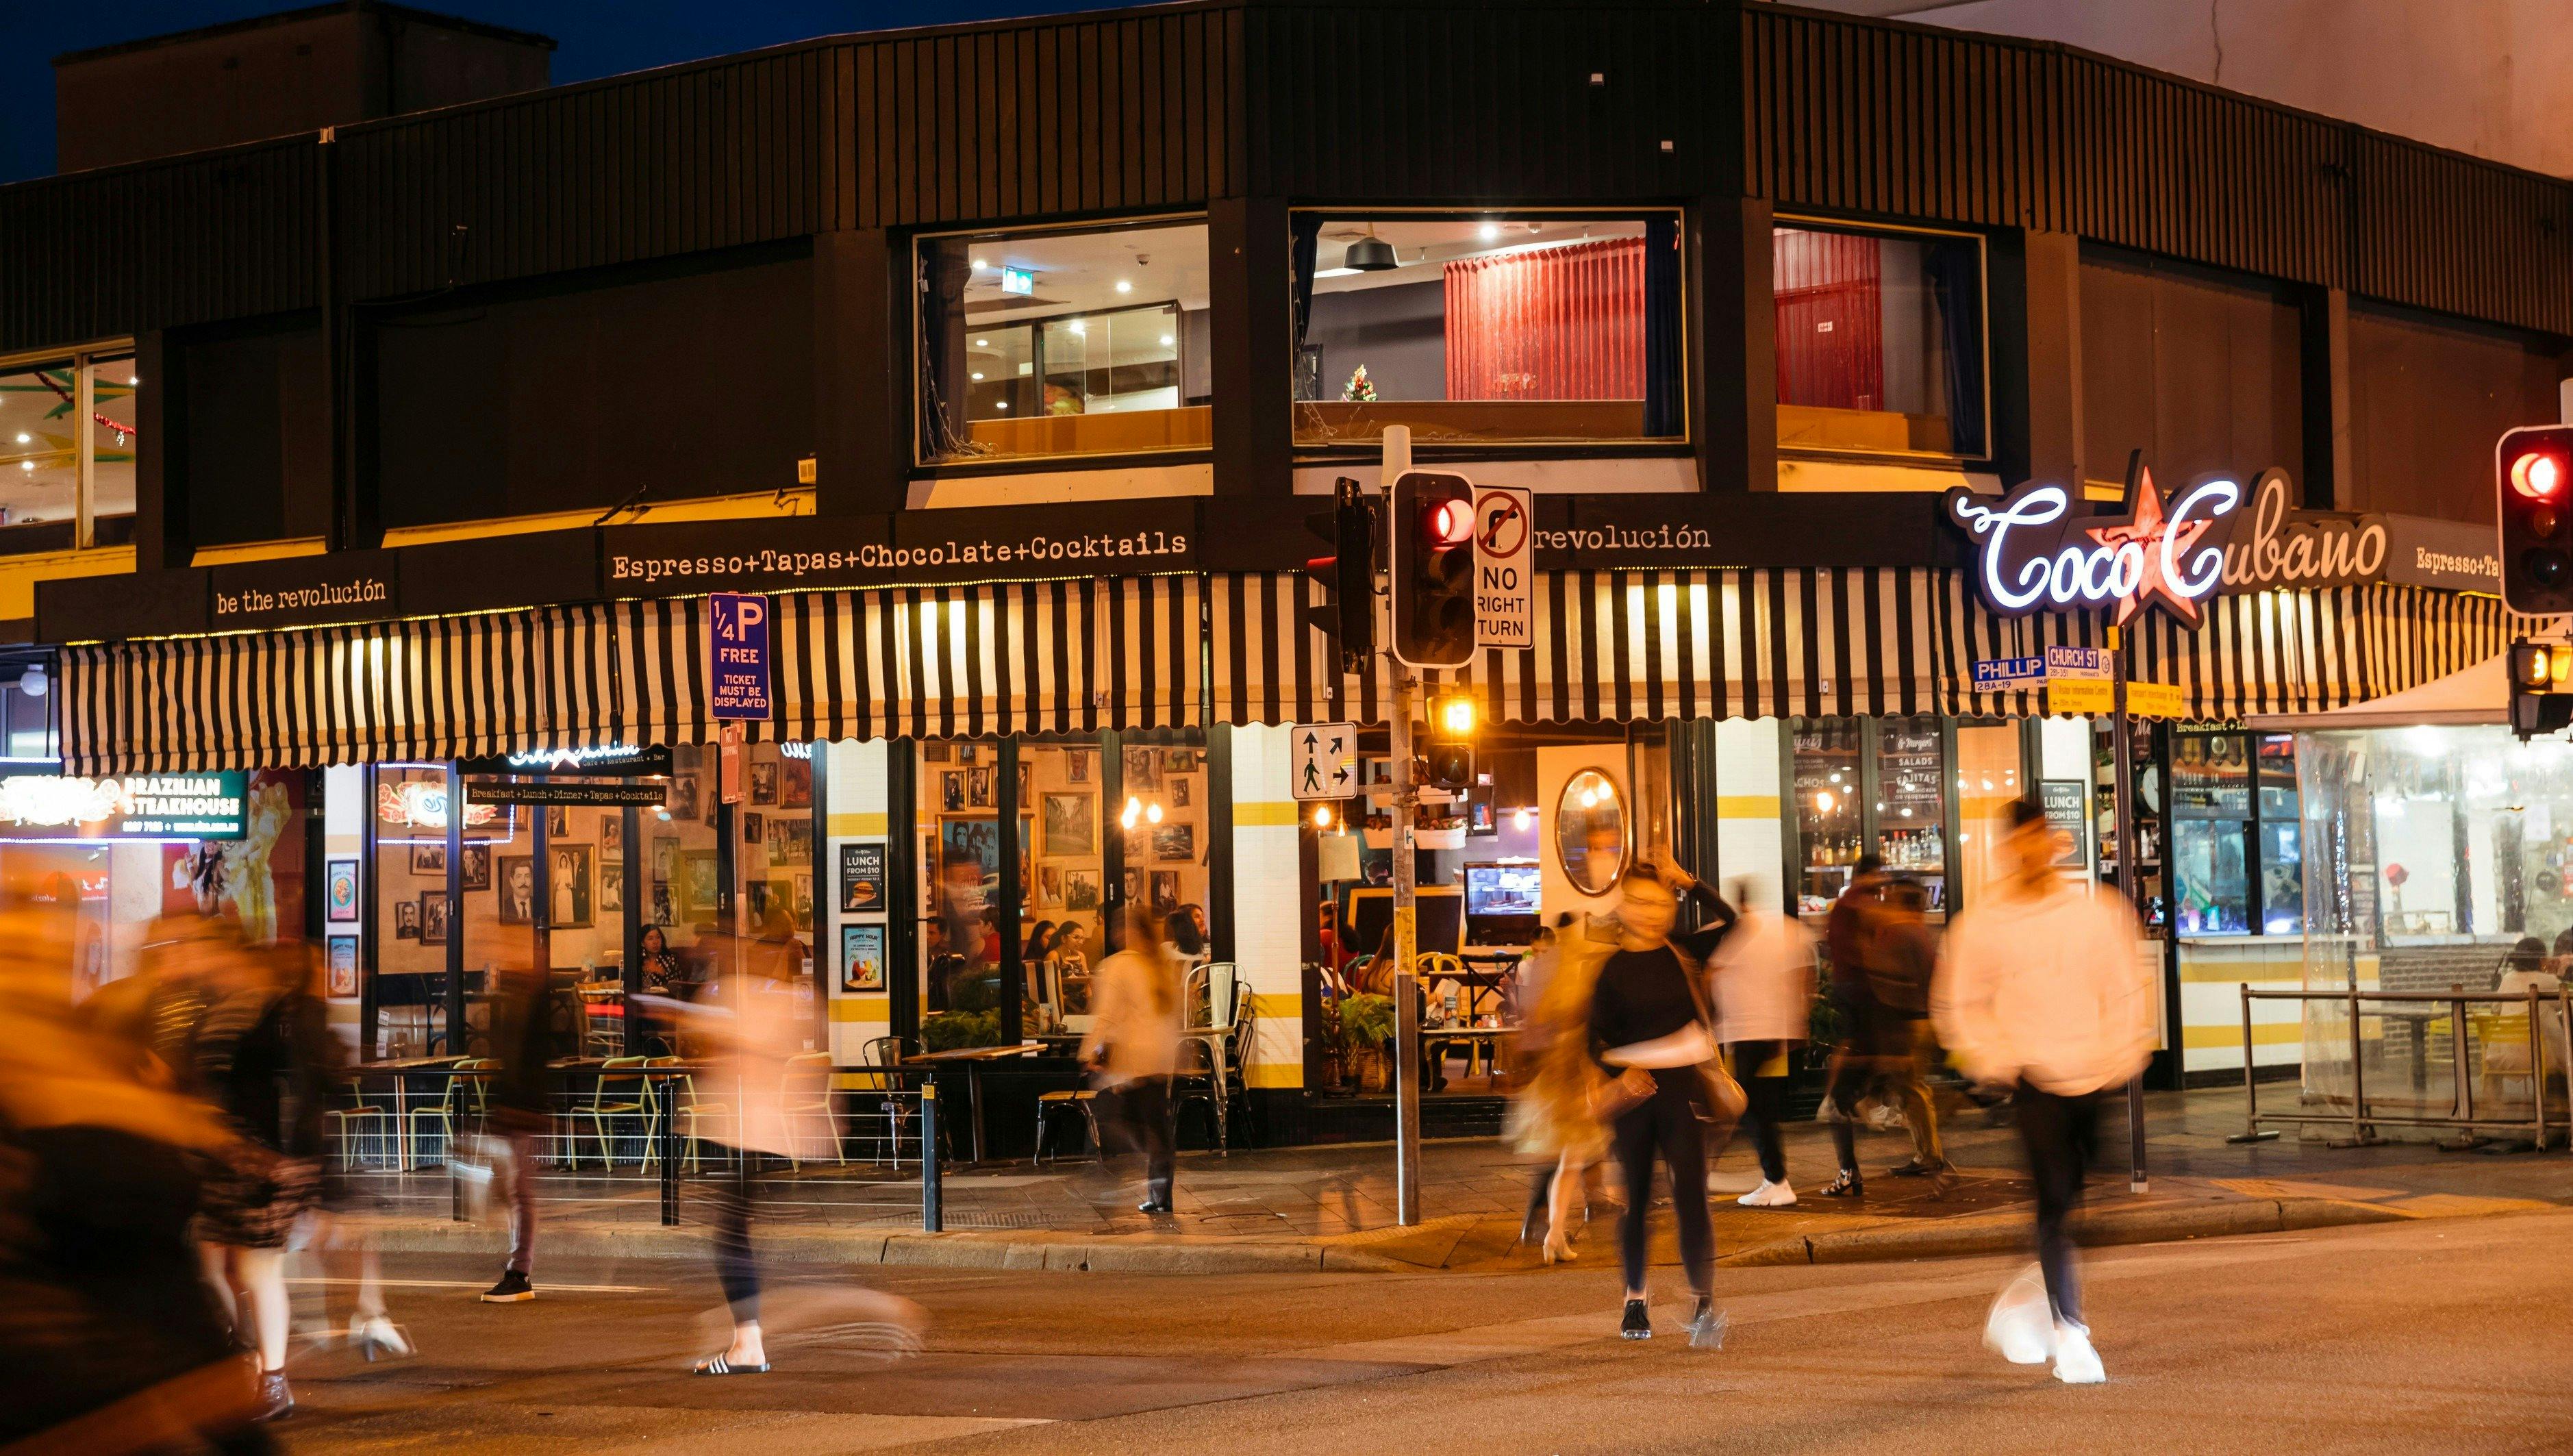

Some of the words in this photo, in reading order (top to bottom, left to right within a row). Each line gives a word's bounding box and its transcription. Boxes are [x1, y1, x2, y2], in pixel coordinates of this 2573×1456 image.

[1534, 524, 1711, 549] revolución
[1955, 486, 2143, 609] Coco
[2161, 476, 2388, 599] Cubano
[613, 531, 1187, 582] Espresso+Tapas+Chocolate+Cocktails
[2416, 547, 2500, 577] Espresso+Ta
[1483, 566, 1517, 590] NO
[217, 593, 238, 614] be
[242, 590, 273, 612] the
[278, 579, 386, 609] revolución
[1478, 597, 1524, 614] RIGHT
[1478, 620, 1523, 636] TURN
[720, 648, 759, 664] FREE
[2050, 648, 2083, 666] CHURCH
[2086, 650, 2097, 668] ST
[1978, 659, 2042, 679] PHILLIP
[724, 675, 757, 685] TICKET
[720, 686, 745, 696] MUST
[749, 687, 762, 696] BE
[714, 696, 767, 708] DISPLAYED
[2176, 723, 2227, 733] Breakfast
[1898, 757, 1933, 766] SALADS
[125, 777, 221, 796] BRAZILIAN
[472, 788, 514, 799] Breakfast
[523, 788, 547, 799] Lunch
[554, 789, 583, 800] Dinner
[590, 790, 614, 802] Tapas
[620, 790, 663, 801] Cocktails
[2044, 796, 2080, 808] LUNCH
[124, 797, 240, 816] STEAKHOUSE
[2044, 811, 2066, 820] FROM
[2066, 810, 2080, 820] $10
[846, 856, 879, 866] LUNCH
[867, 866, 880, 875] $10
